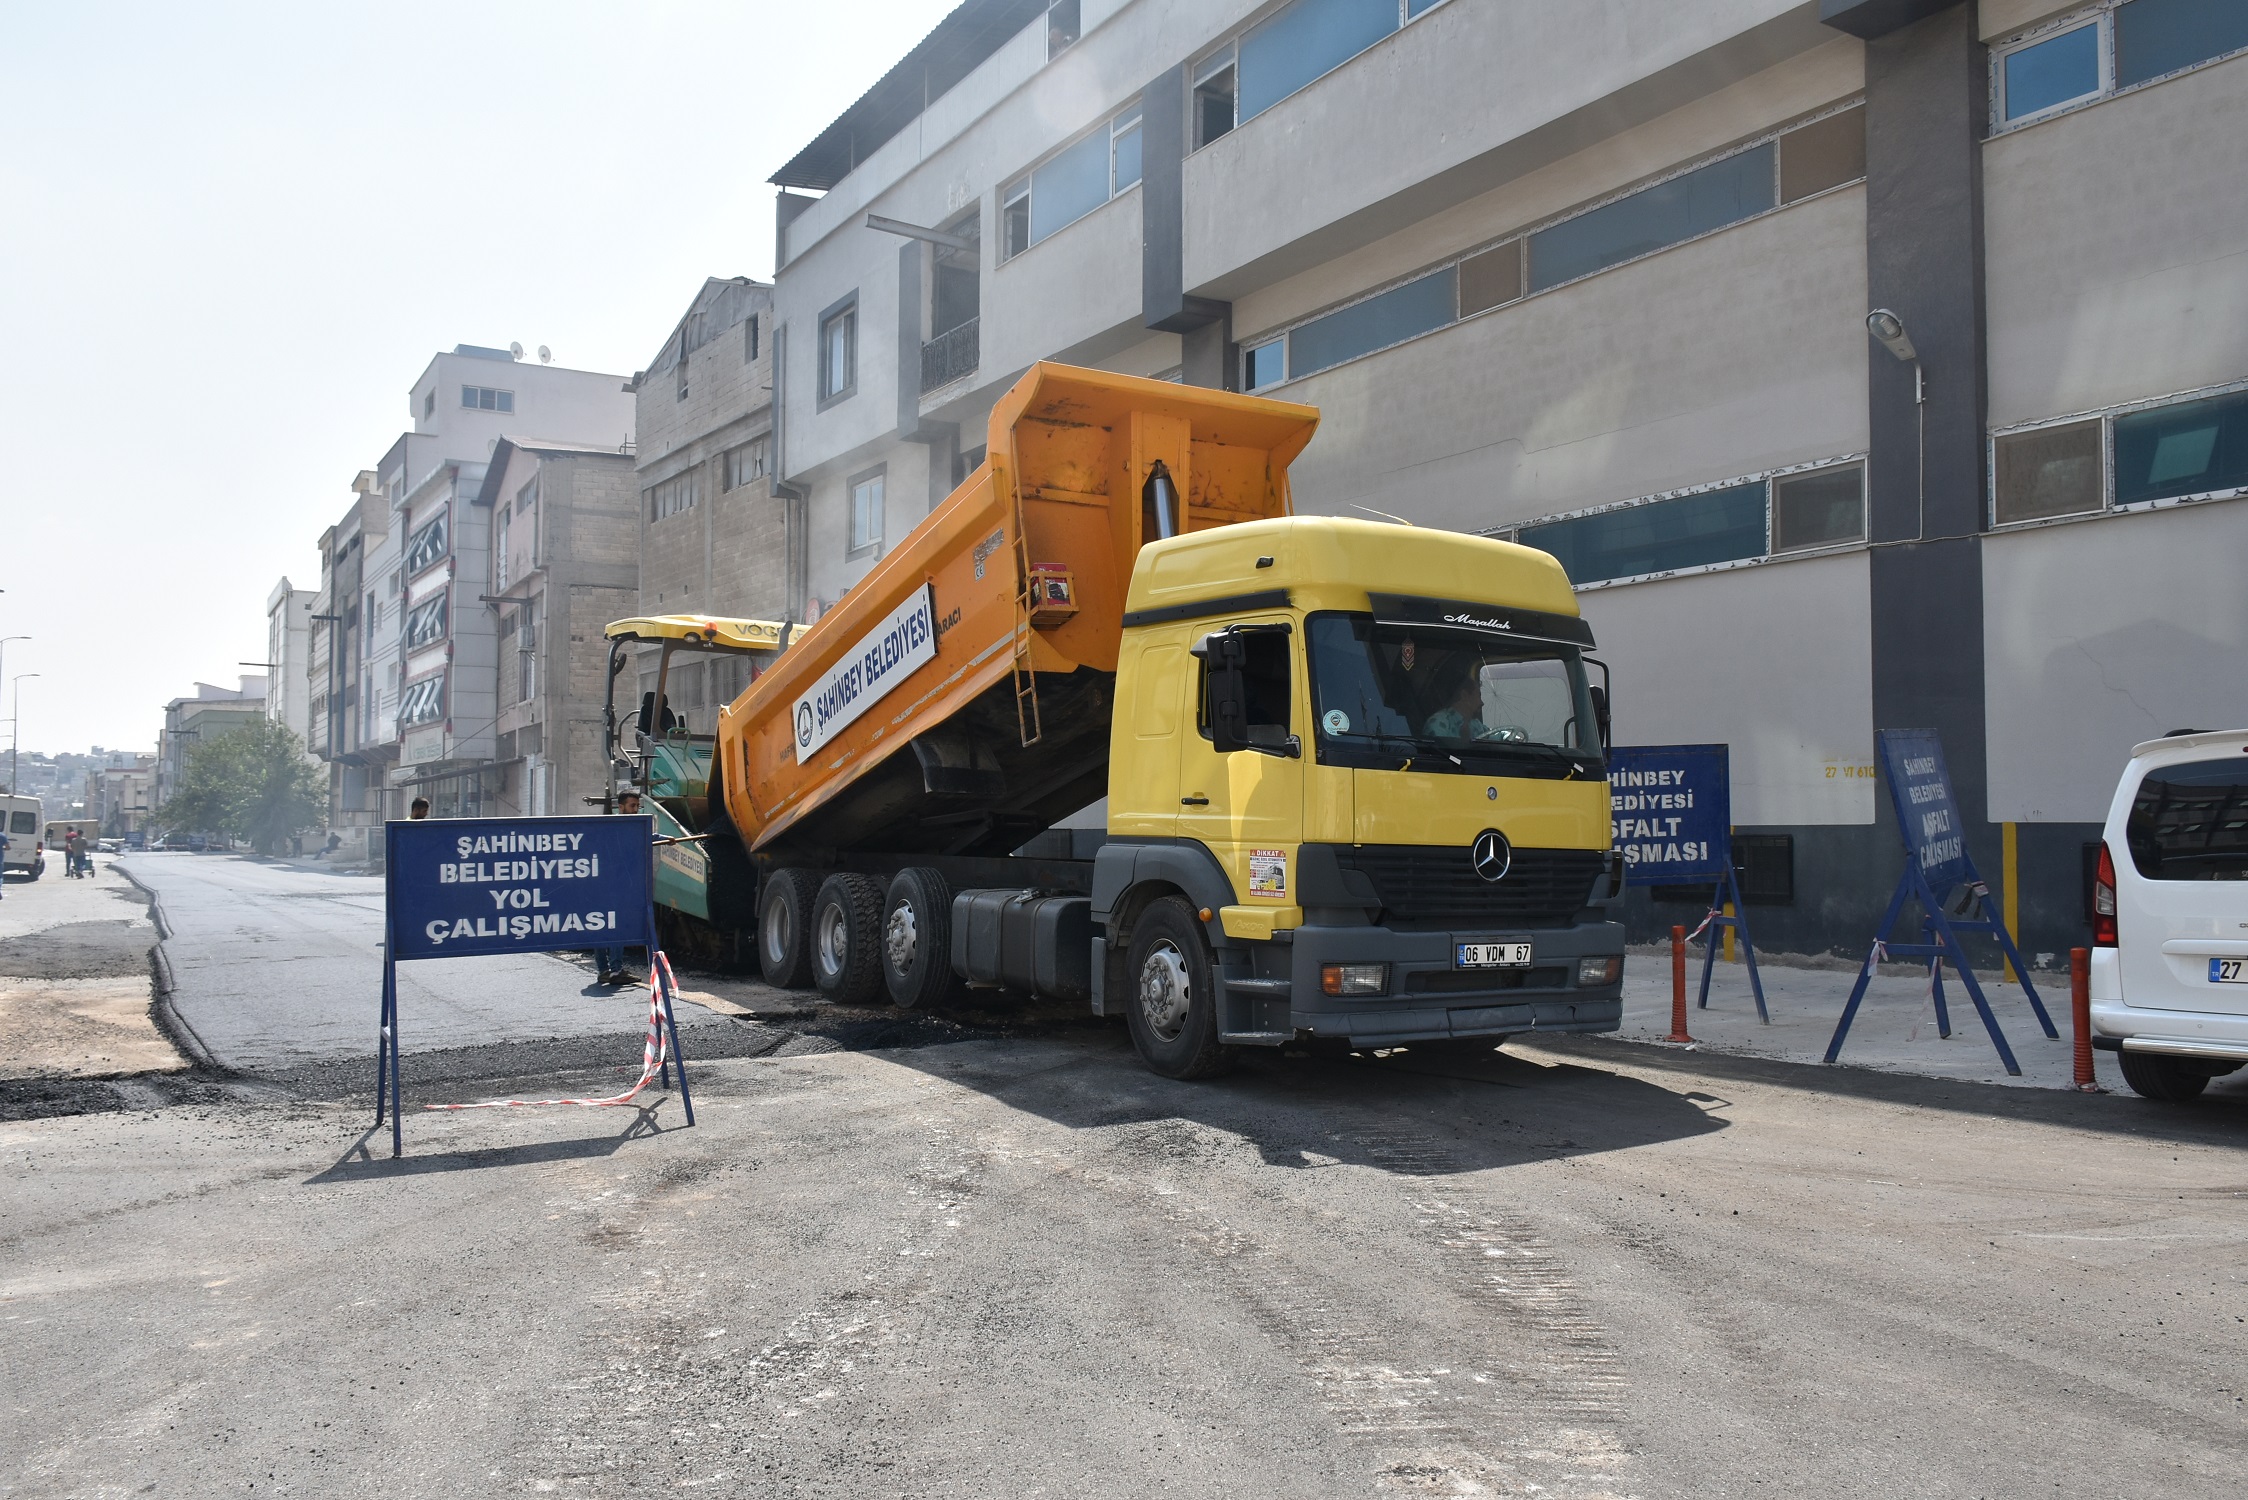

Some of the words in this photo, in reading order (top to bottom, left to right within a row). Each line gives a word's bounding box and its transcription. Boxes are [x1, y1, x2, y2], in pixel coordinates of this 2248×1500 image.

[816, 660, 863, 736] ŞAHİNBEY
[864, 594, 930, 687] BELEDİYESİ
[1606, 767, 1685, 787] HİNBEY
[1825, 766, 1837, 779] 27
[1611, 788, 1694, 811] EDİYESİ
[457, 831, 584, 859] ŞAHİNBEY
[440, 853, 599, 884] BELEDİYESİ
[489, 888, 550, 910] YOL
[426, 911, 616, 945] ÇALIŞMASI
[1465, 946, 1478, 962] 06
[1486, 945, 1505, 962] VDM
[1516, 945, 1530, 961] 67
[2220, 961, 2242, 980] 27
